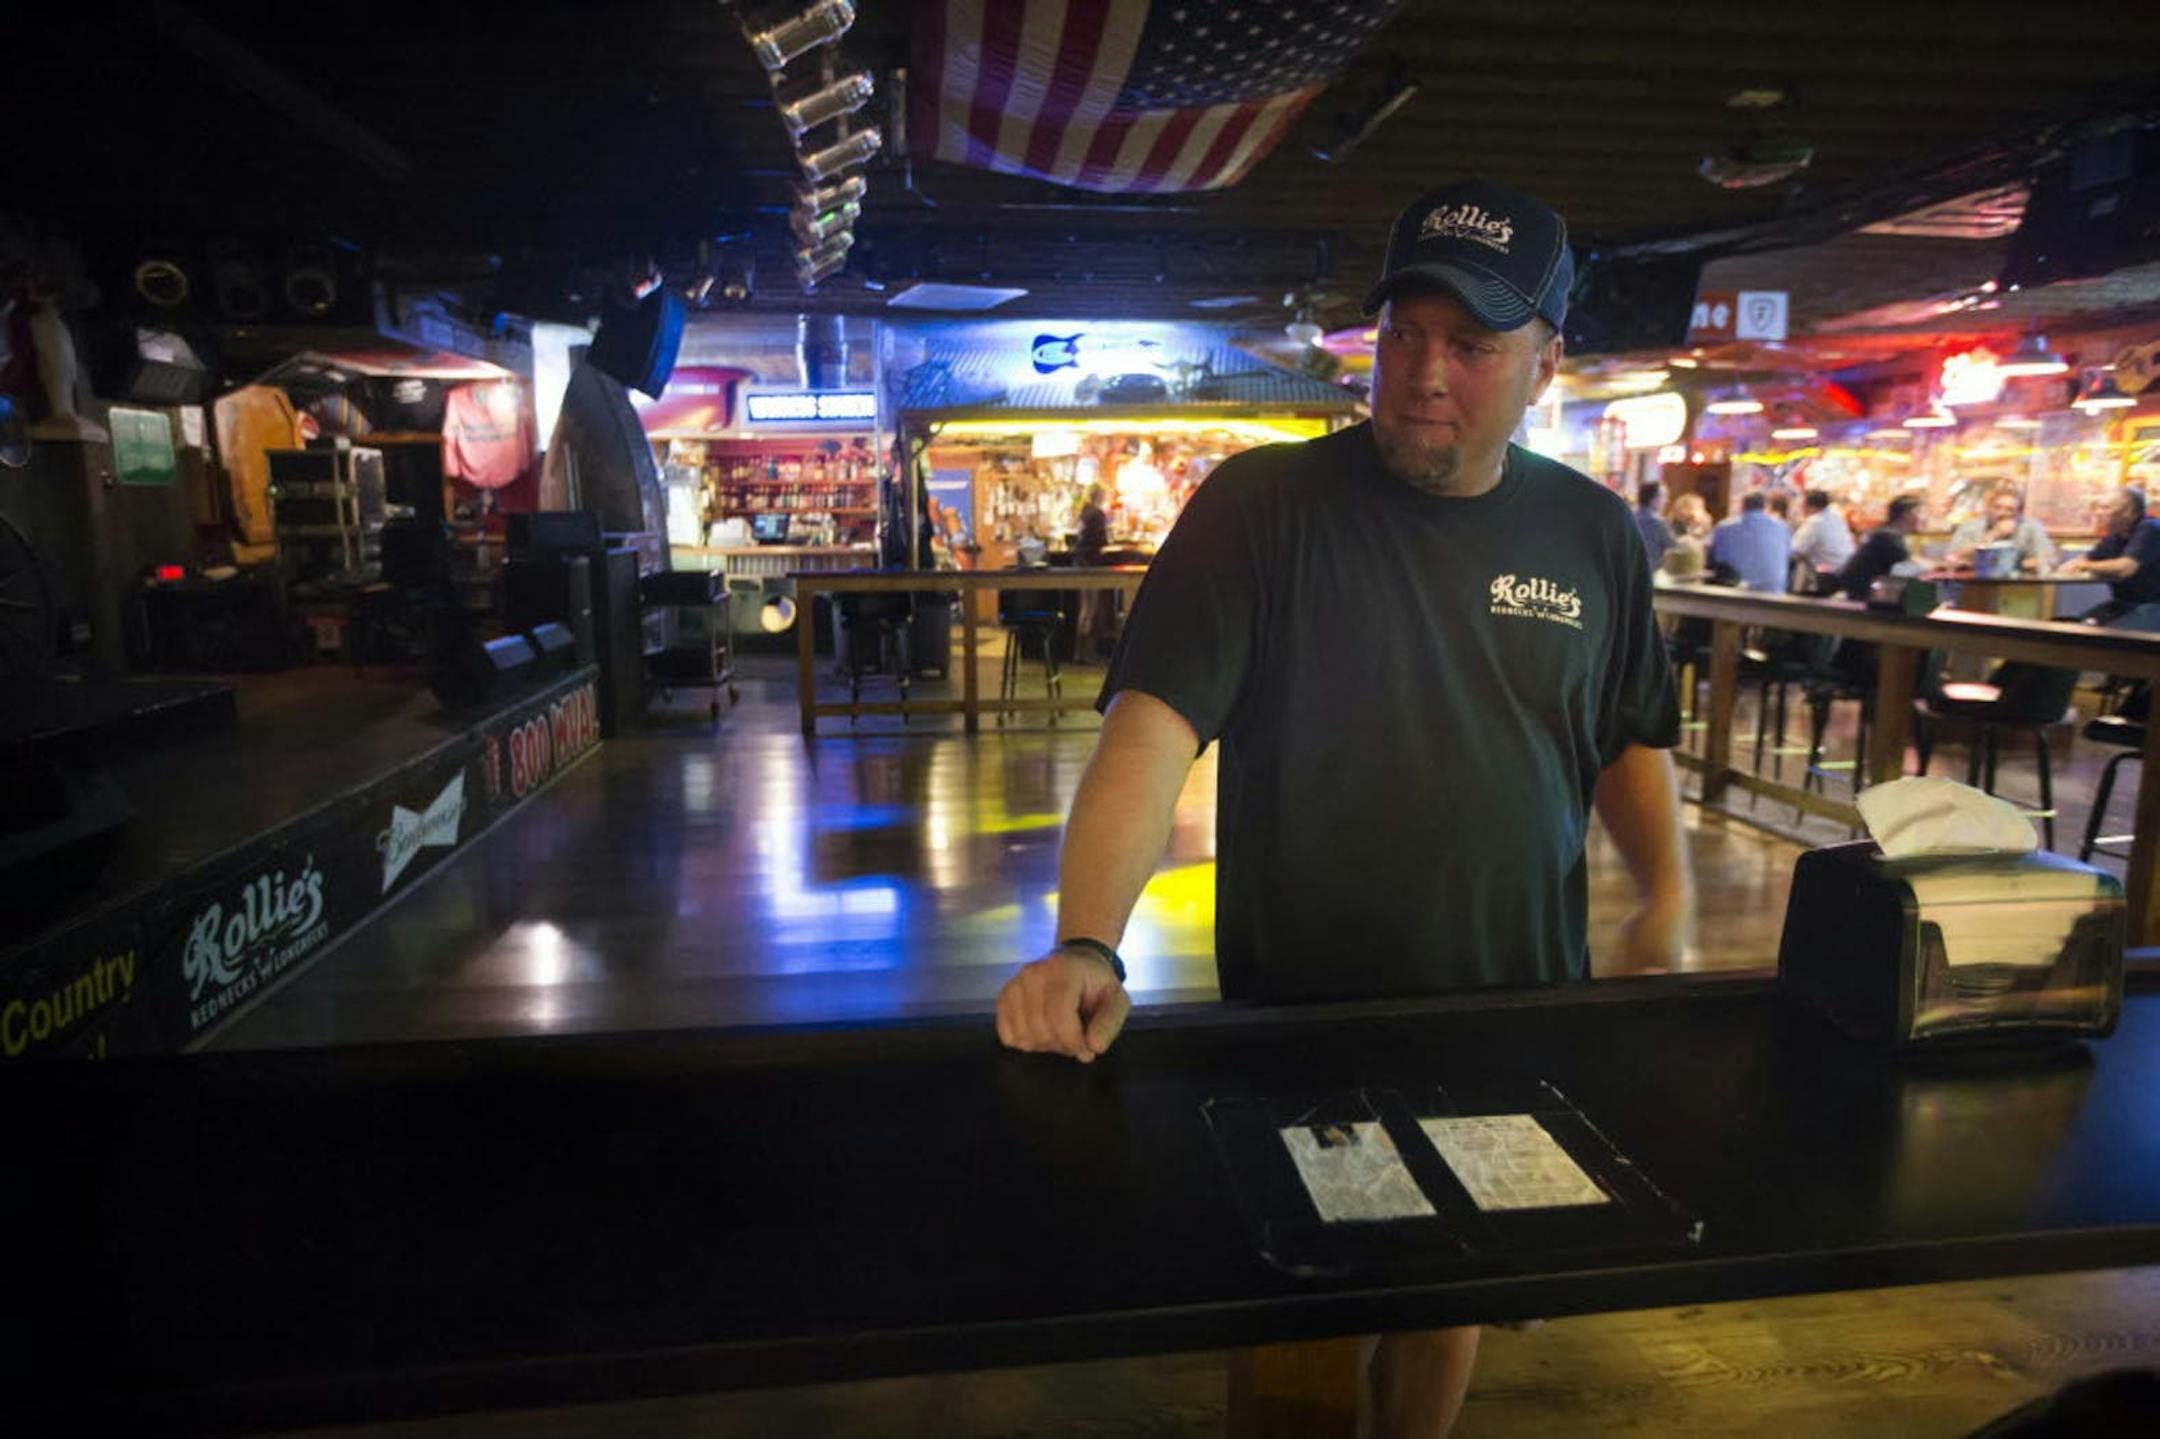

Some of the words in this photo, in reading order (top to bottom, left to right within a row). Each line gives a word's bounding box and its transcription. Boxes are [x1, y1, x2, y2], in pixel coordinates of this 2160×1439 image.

[1420, 203, 1513, 243] Rollie's
[1490, 573, 1582, 618] Rollie's
[510, 712, 551, 798] 800
[182, 852, 324, 1002] Rollie's
[1, 948, 136, 1057] Country
